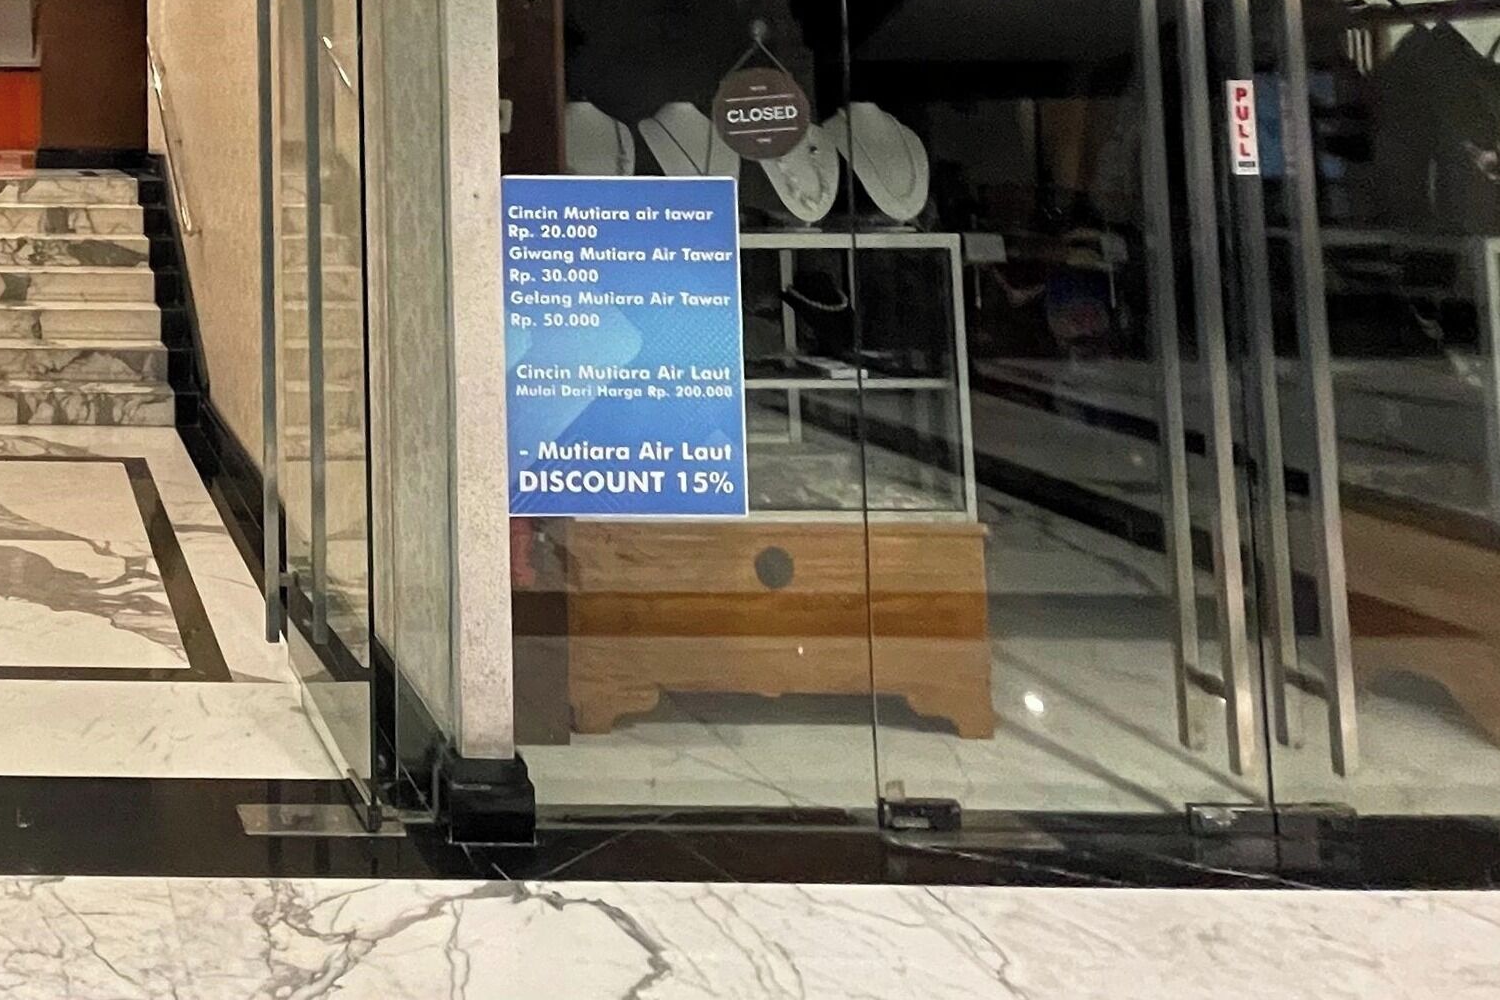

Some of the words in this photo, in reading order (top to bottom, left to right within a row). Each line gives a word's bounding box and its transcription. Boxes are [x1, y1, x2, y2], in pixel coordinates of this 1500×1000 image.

[727, 105, 798, 123] CLOSED
[1235, 87, 1251, 157] PULL
[508, 206, 558, 220] Cincin
[564, 207, 629, 221] Mutiara
[636, 207, 659, 221] air
[665, 208, 713, 222] tawar
[508, 225, 534, 240] Rp.
[539, 225, 598, 238] 20.000
[509, 248, 574, 264] Giwang
[580, 248, 646, 262] Mutiara
[652, 248, 677, 262] Air
[682, 249, 732, 262] Tawar
[510, 269, 536, 284] Rp.
[541, 269, 599, 283] 30.000
[511, 292, 571, 308] Gelang
[578, 292, 644, 306] Mutiara
[650, 293, 675, 306] Air
[680, 294, 731, 307] Tawar
[511, 314, 536, 329] Rp.
[544, 314, 600, 327] 50.000
[516, 365, 570, 380] Cincin
[578, 365, 650, 380] Mutiara
[657, 366, 684, 381] Air
[691, 367, 731, 381] Laut
[515, 385, 555, 397] Mulai
[561, 385, 592, 397] Dari
[598, 385, 642, 400] Harga
[648, 386, 669, 399] Rp.
[675, 387, 732, 398] 200.000
[538, 442, 629, 460] Mutiara
[639, 442, 673, 460] Air
[682, 443, 732, 461] Laut
[519, 471, 665, 493] DISCOUNT
[677, 471, 734, 494] 15%
